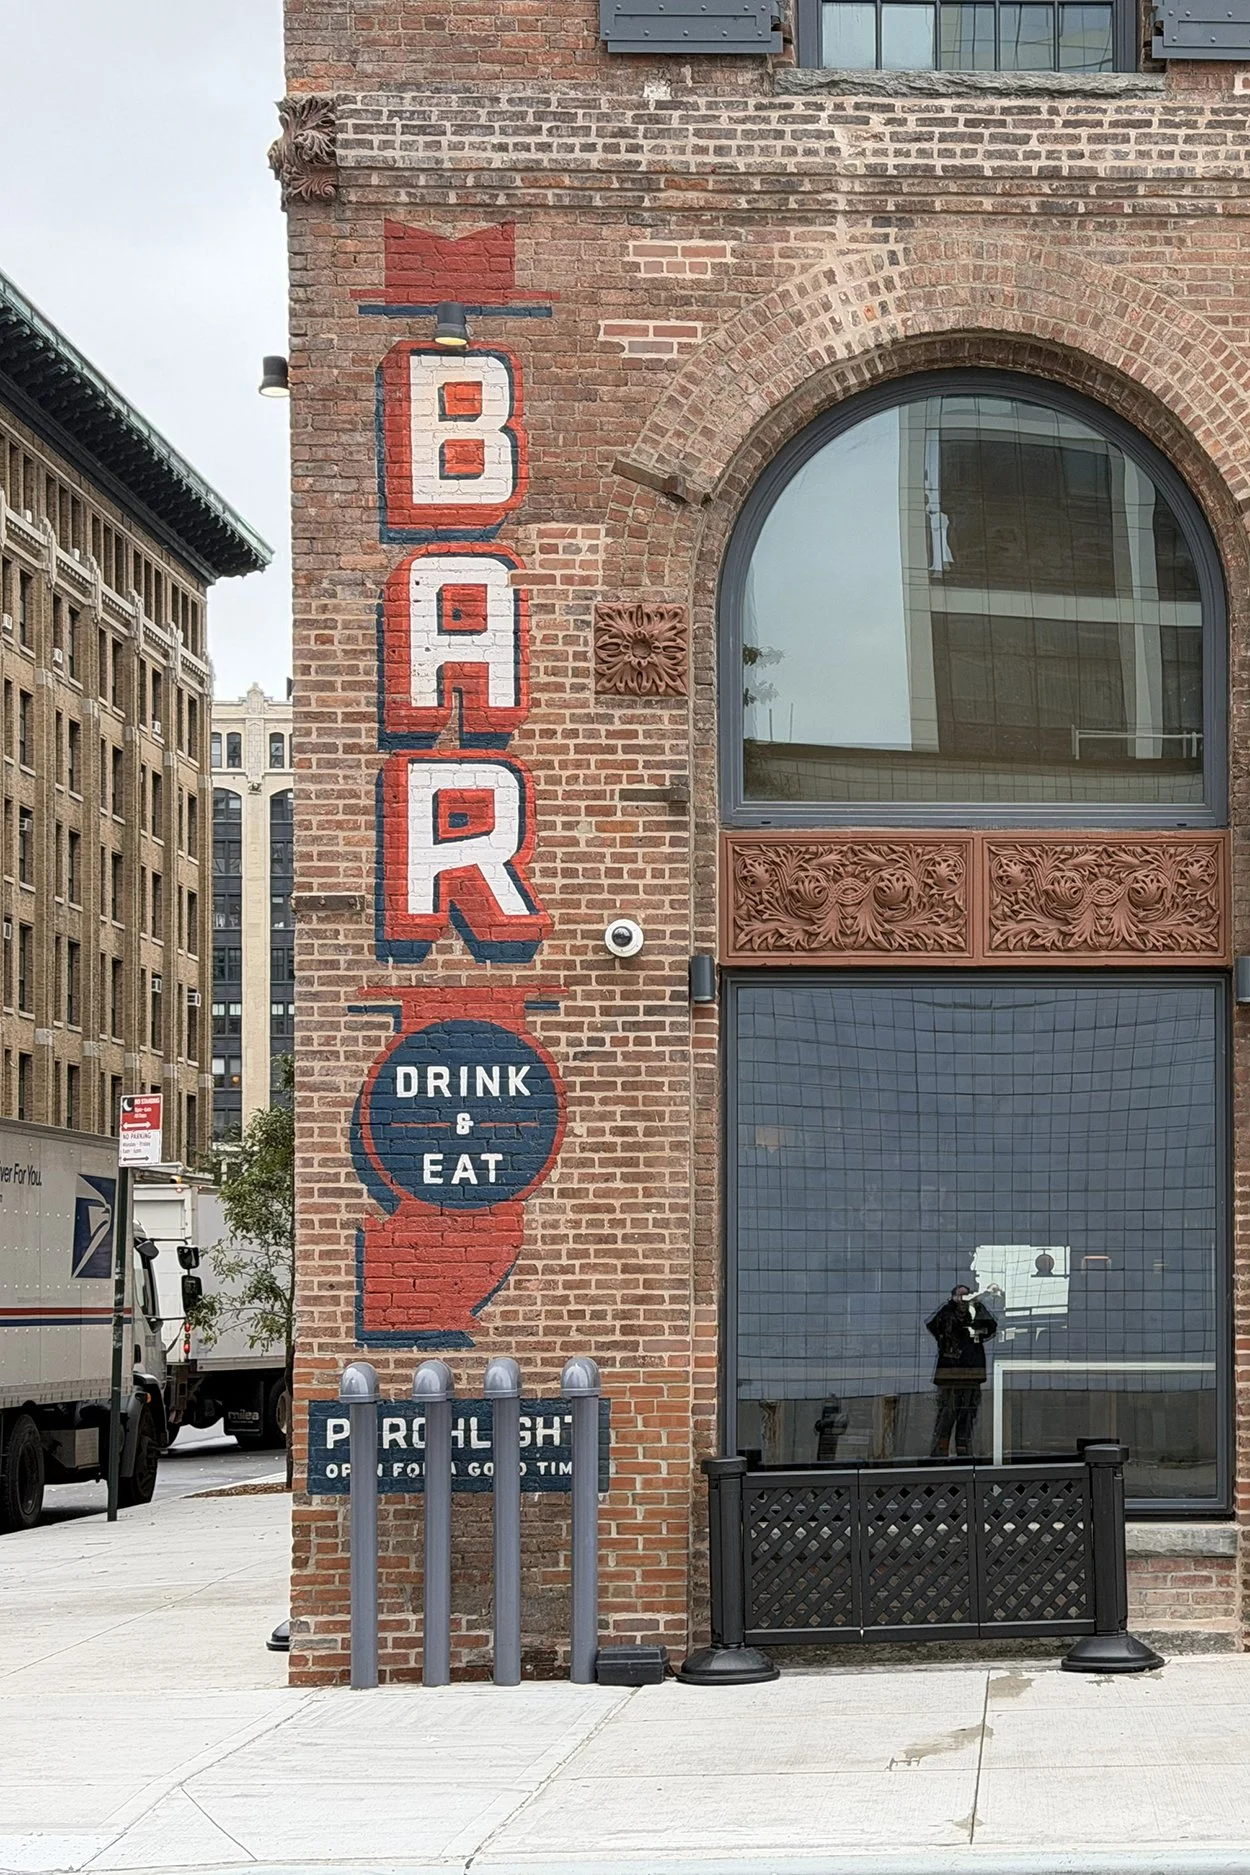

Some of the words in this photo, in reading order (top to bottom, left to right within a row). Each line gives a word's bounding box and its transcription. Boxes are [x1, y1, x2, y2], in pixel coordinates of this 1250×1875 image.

[408, 354, 532, 916] BAR
[396, 1066, 531, 1097] DRINK
[456, 1113, 474, 1135] &
[14, 1163, 27, 1184] For
[423, 1153, 503, 1184] EAT
[536, 1462, 572, 1476] TIM
